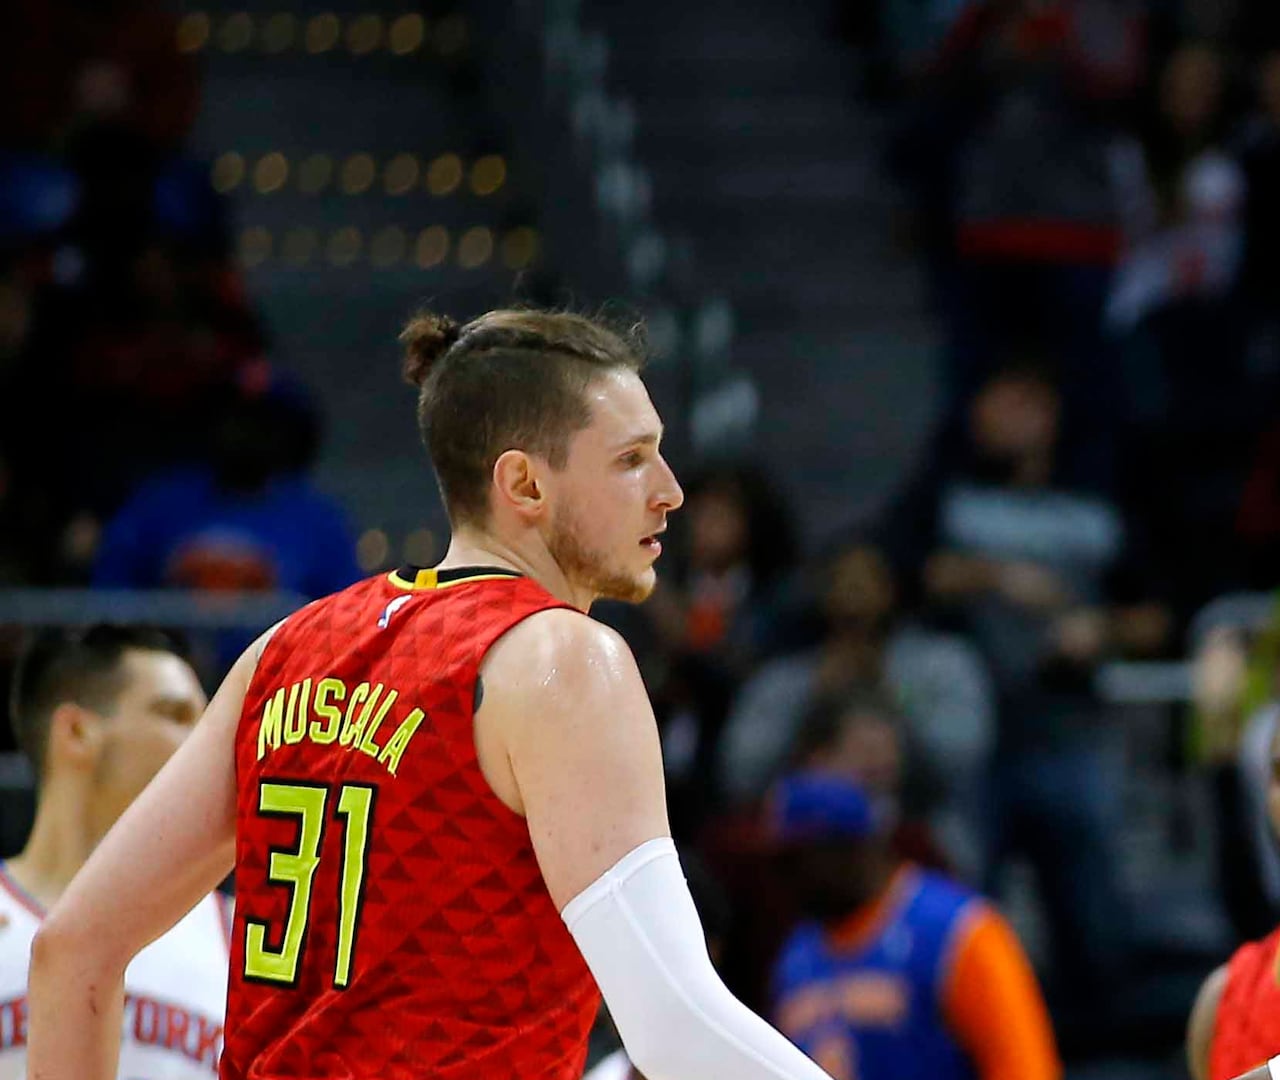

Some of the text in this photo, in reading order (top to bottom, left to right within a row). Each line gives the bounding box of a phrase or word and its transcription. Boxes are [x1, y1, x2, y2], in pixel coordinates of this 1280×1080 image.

[257, 677, 426, 775] MUSCALA
[243, 780, 375, 990] 31
[124, 995, 223, 1073] ORK
